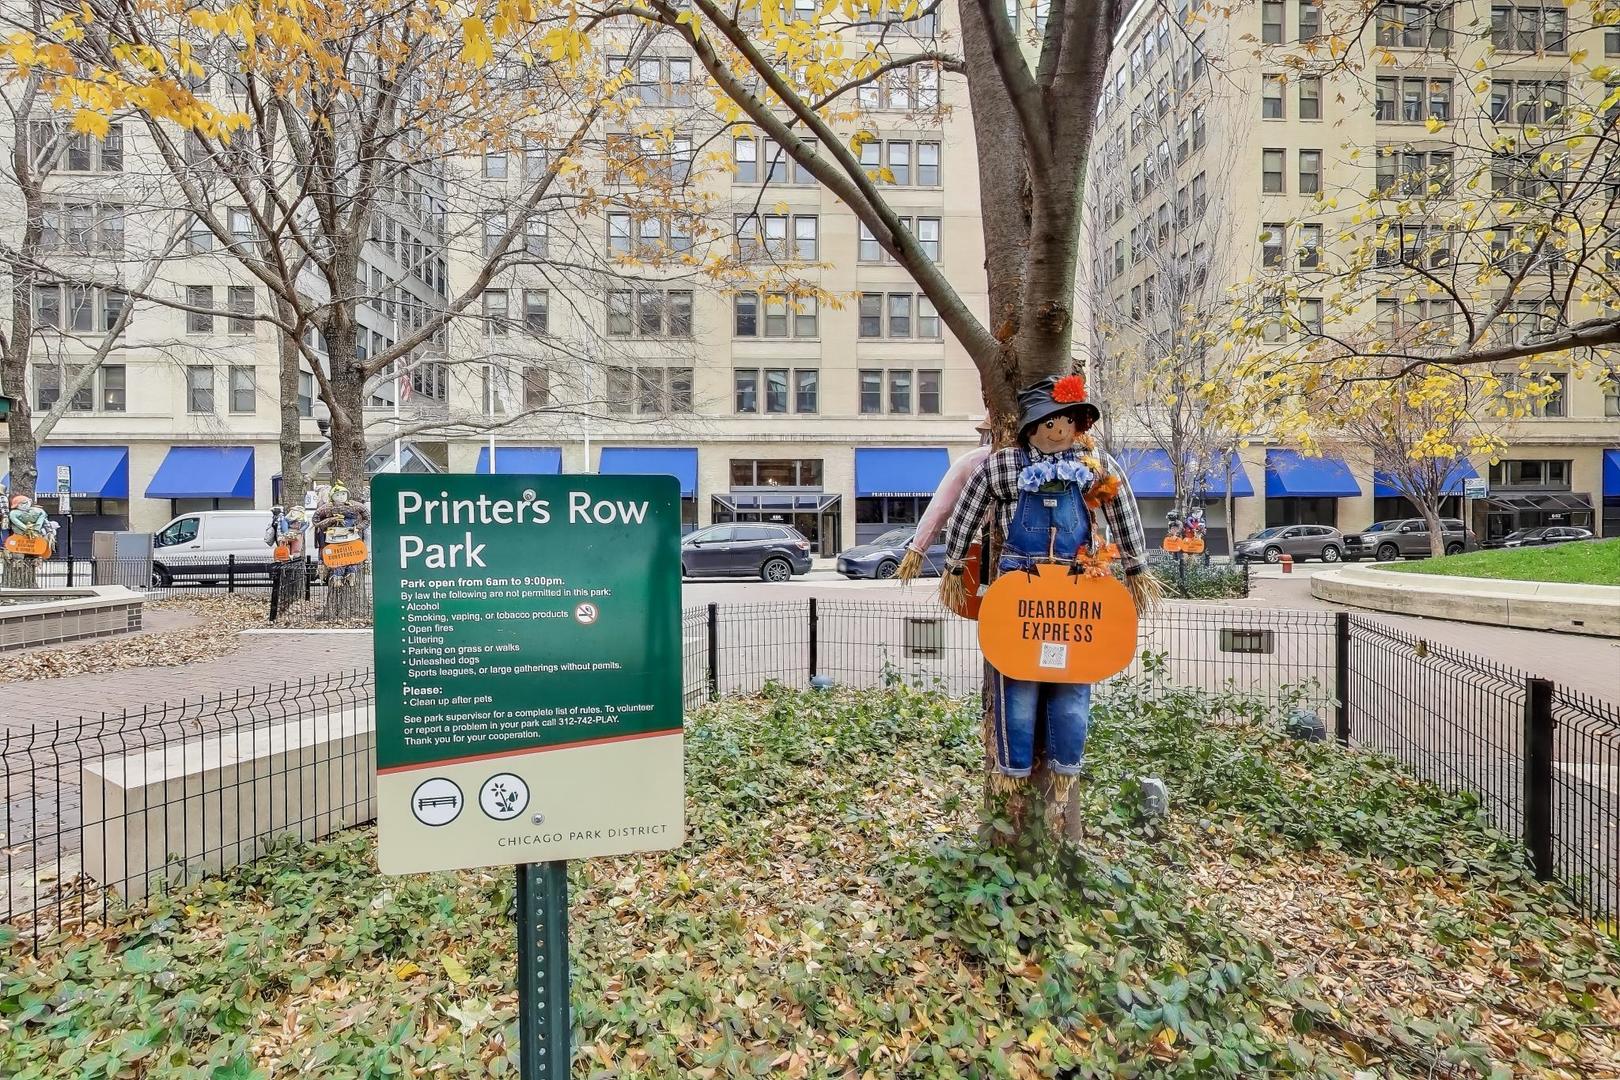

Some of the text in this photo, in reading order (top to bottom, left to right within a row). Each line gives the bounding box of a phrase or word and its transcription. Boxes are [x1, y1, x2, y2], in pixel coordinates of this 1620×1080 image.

[569, 492, 649, 524] Row
[400, 532, 487, 568] Park
[401, 576, 565, 589] Park open from 6am to 9:00pm.
[401, 592, 412, 601] By
[449, 590, 487, 599] following
[522, 588, 561, 598] permitted
[590, 588, 612, 597] park:
[408, 614, 449, 622] Smoking,
[452, 612, 482, 621] vaping,
[496, 611, 530, 619] tobacco
[532, 610, 569, 620] products
[1018, 600, 1102, 620] DEARBORN
[408, 625, 432, 633] Open
[1022, 622, 1093, 642] EXPRESS
[408, 636, 444, 645] Littering
[408, 646, 442, 656] Parking
[458, 645, 482, 654] grass
[496, 643, 520, 651] walks
[408, 656, 480, 666] Unleashed dogs
[408, 668, 437, 678] Sports
[440, 667, 477, 677] leagues,
[490, 665, 512, 674] large
[514, 664, 559, 674] gatherings
[560, 662, 590, 671] without
[403, 686, 443, 696] Please:
[410, 695, 493, 706] Clean up after pets
[404, 715, 422, 724] See
[424, 714, 444, 724] park
[446, 712, 491, 722] supervisor
[515, 708, 554, 718] complete
[556, 707, 568, 715] list
[570, 706, 579, 714] of
[580, 706, 603, 714] rules.
[605, 705, 615, 713] To
[616, 704, 655, 712] volunteer
[416, 725, 442, 735] report
[452, 722, 488, 732] problem
[500, 722, 519, 730] your
[521, 719, 540, 729] park
[542, 718, 557, 727] call
[558, 715, 620, 726] 312-742-PLAY.
[404, 730, 541, 746] Thank you for your cooperation.
[498, 824, 668, 847] CHICAGO PARK DISTRICT
